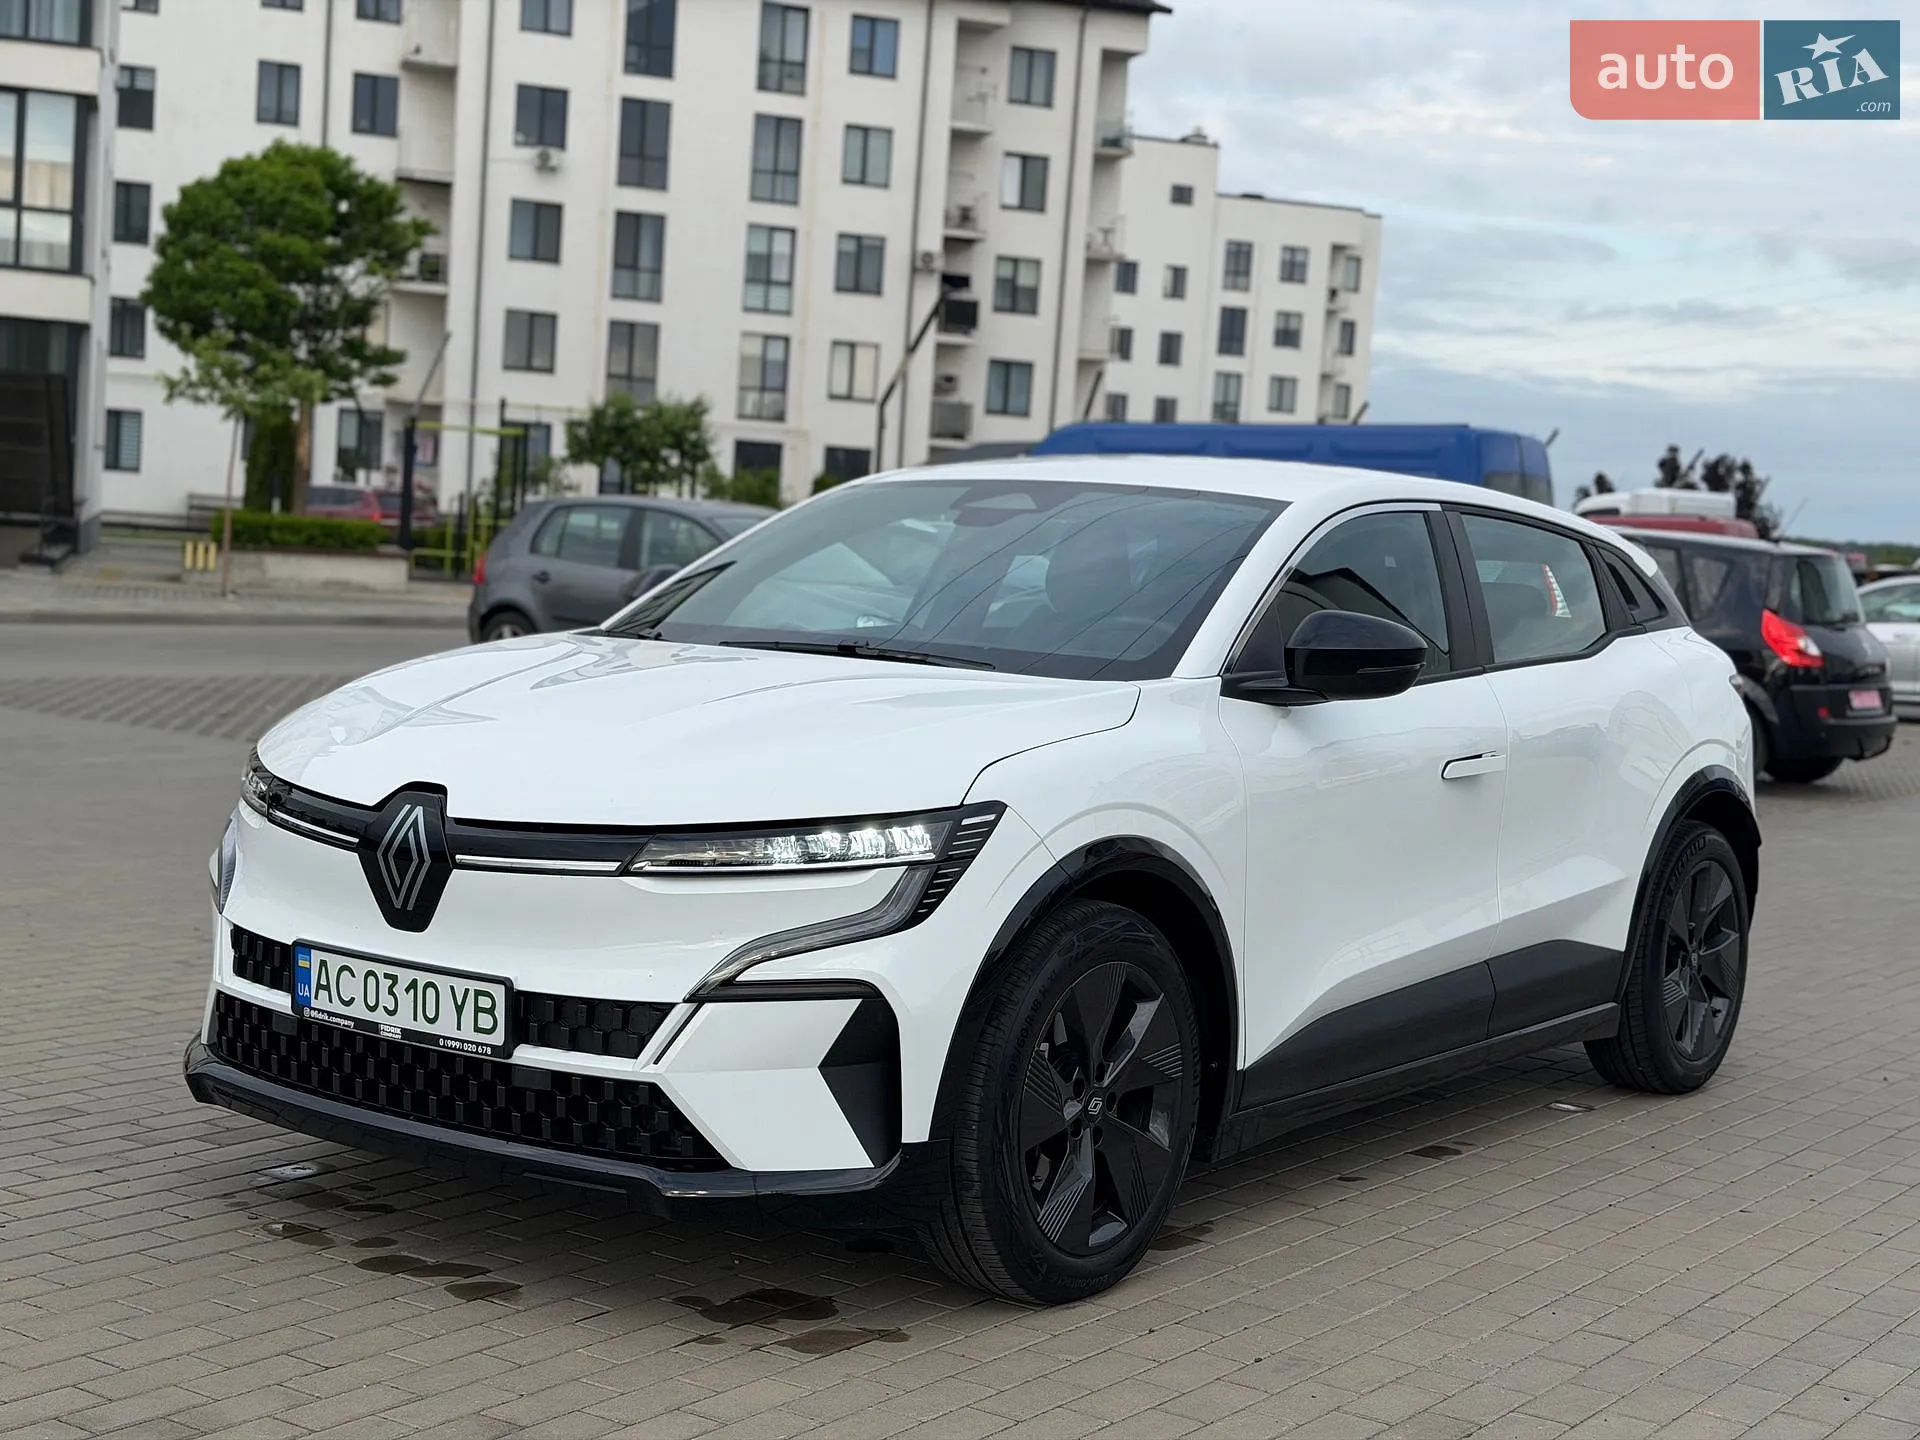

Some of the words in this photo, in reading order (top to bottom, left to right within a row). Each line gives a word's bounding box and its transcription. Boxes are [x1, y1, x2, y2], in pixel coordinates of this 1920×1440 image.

[298, 983, 310, 998] UA
[314, 958, 356, 1007] AC
[363, 969, 440, 1025] 0310
[449, 985, 498, 1035] YB
[439, 1038, 444, 1046] 0
[445, 1040, 462, 1049] (999)
[463, 1043, 477, 1052] 020
[478, 1045, 491, 1055] 678
